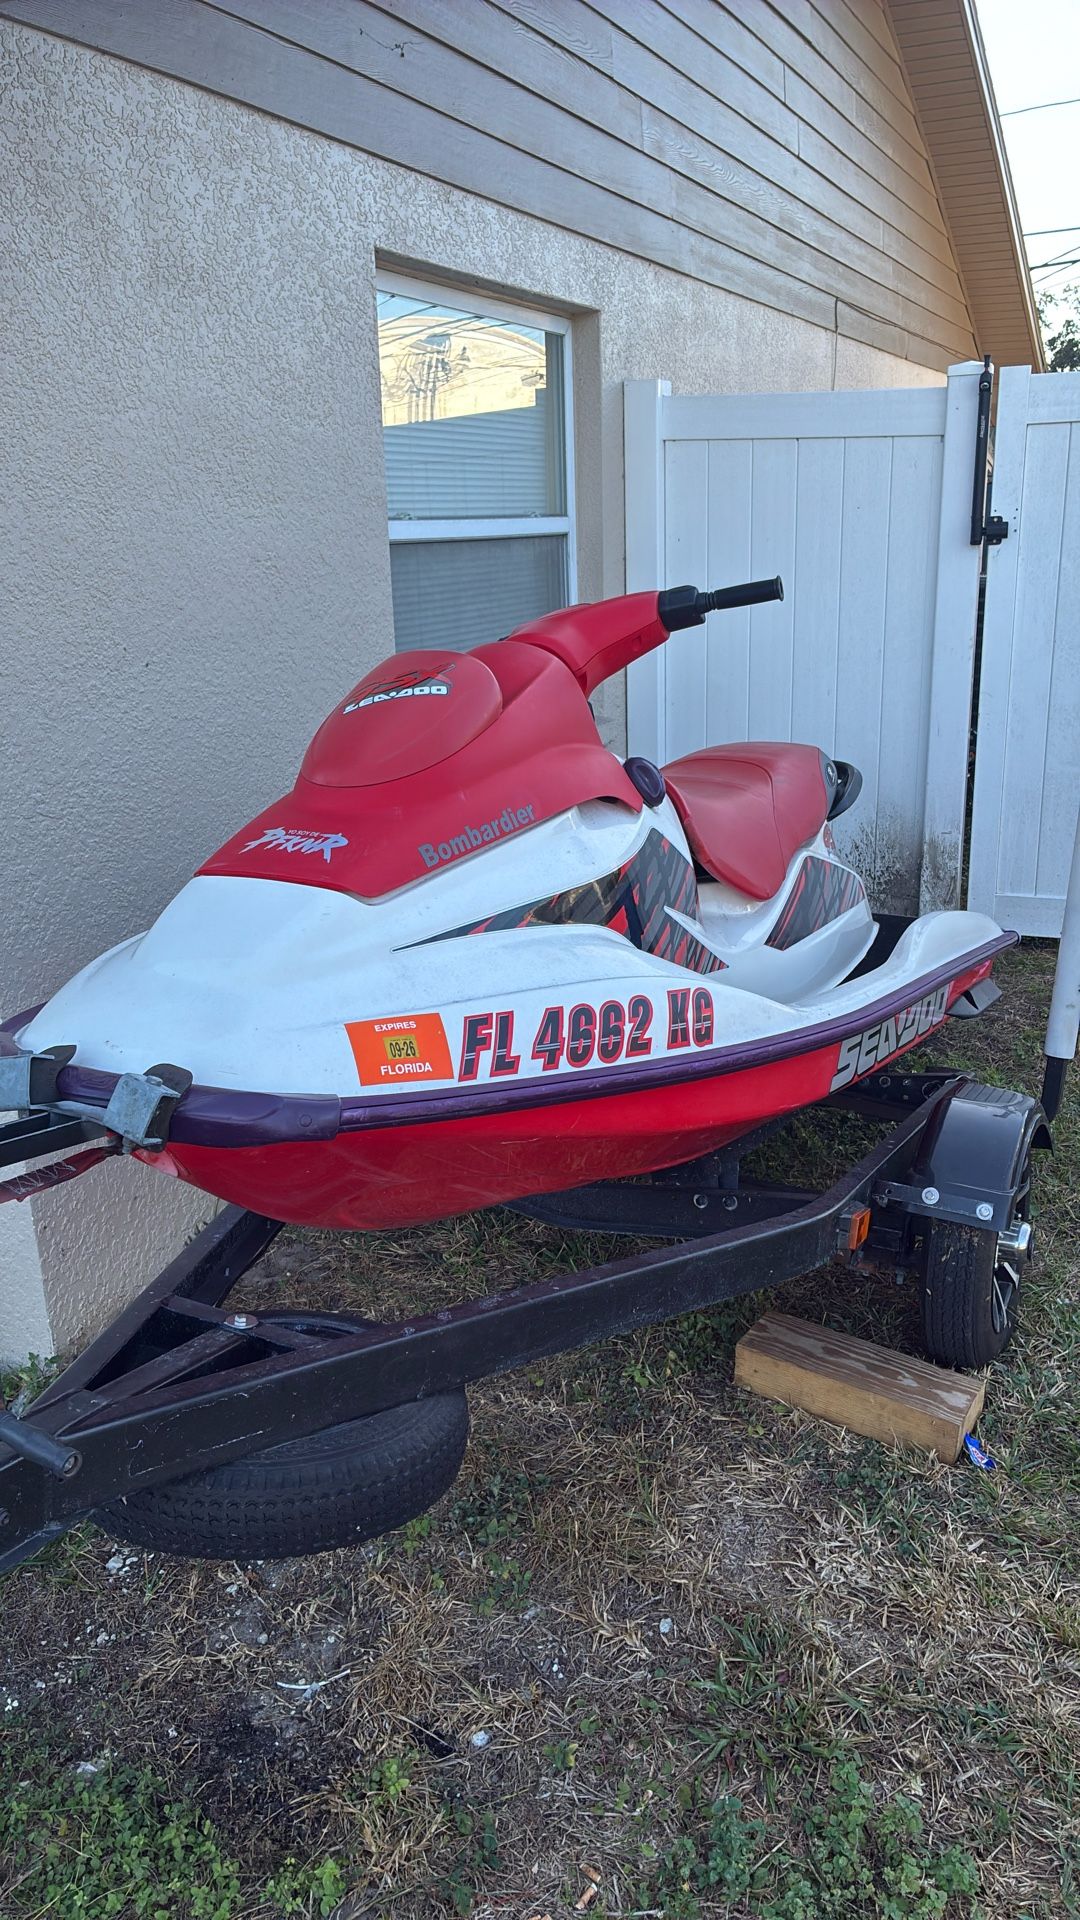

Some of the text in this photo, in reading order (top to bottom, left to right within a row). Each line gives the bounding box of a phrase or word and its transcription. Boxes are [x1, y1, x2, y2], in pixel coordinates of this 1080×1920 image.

[417, 803, 536, 867] Bombardier
[374, 1021, 417, 1032] EXPIRES
[458, 1010, 520, 1082] FL
[531, 994, 653, 1071] 4662
[389, 1040, 416, 1058] 09-26
[380, 1062, 433, 1076] FLORIDA
